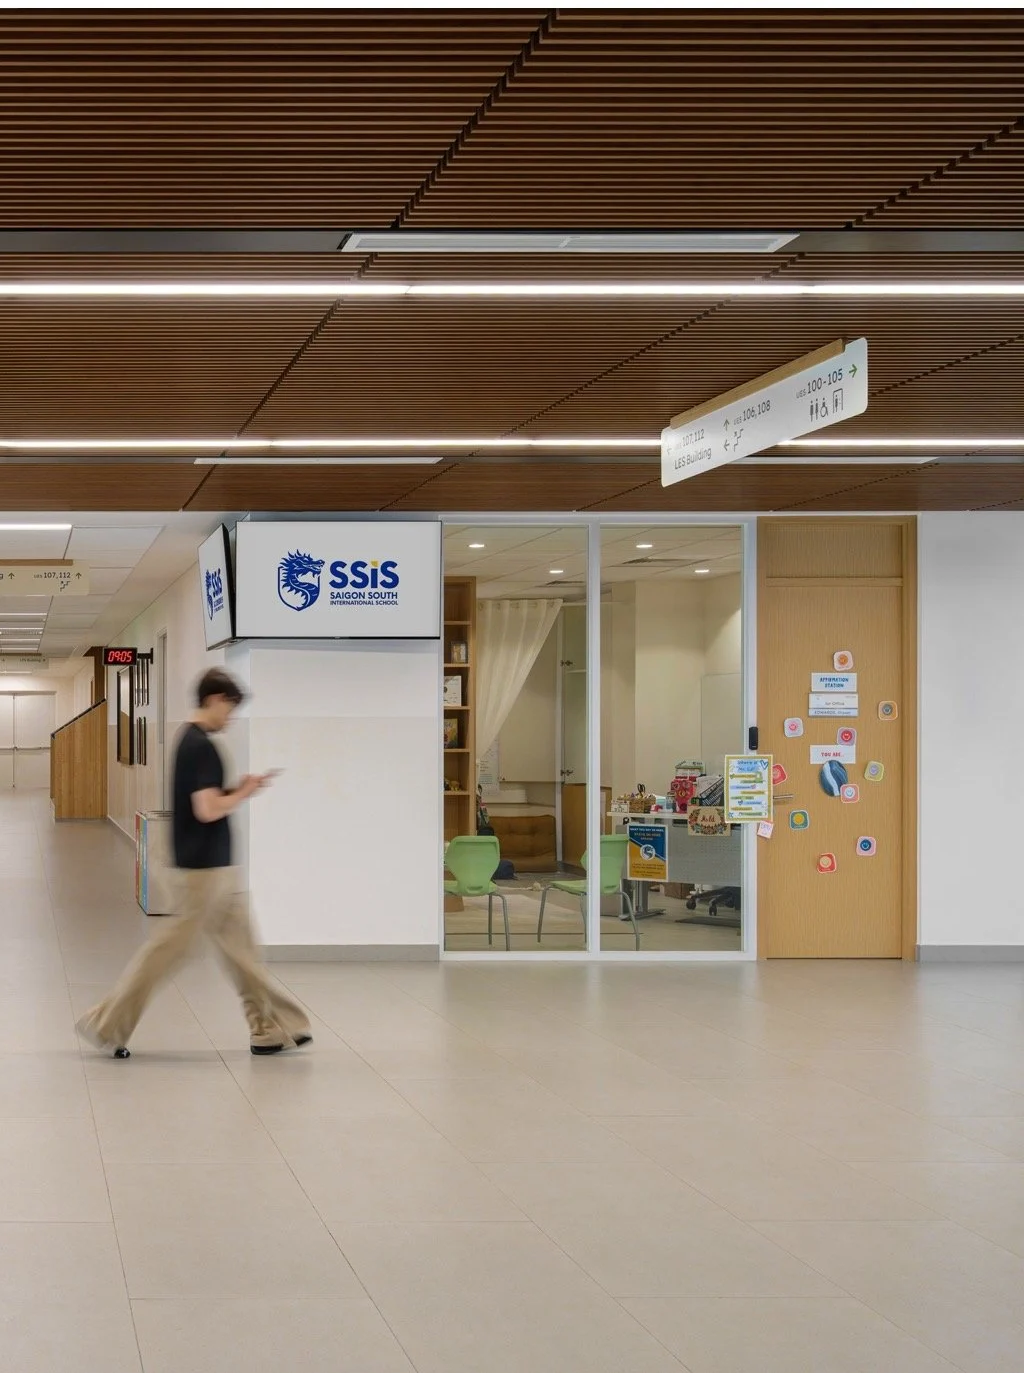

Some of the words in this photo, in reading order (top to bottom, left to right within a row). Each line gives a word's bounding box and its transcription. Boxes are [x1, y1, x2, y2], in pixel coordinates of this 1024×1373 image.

[796, 388, 806, 398] UES
[808, 368, 844, 394] 100-105
[742, 400, 771, 422] 106,108
[682, 428, 705, 448] 107,112
[674, 456, 686, 470] LES
[686, 448, 712, 465] Building
[108, 650, 132, 662] 09:05
